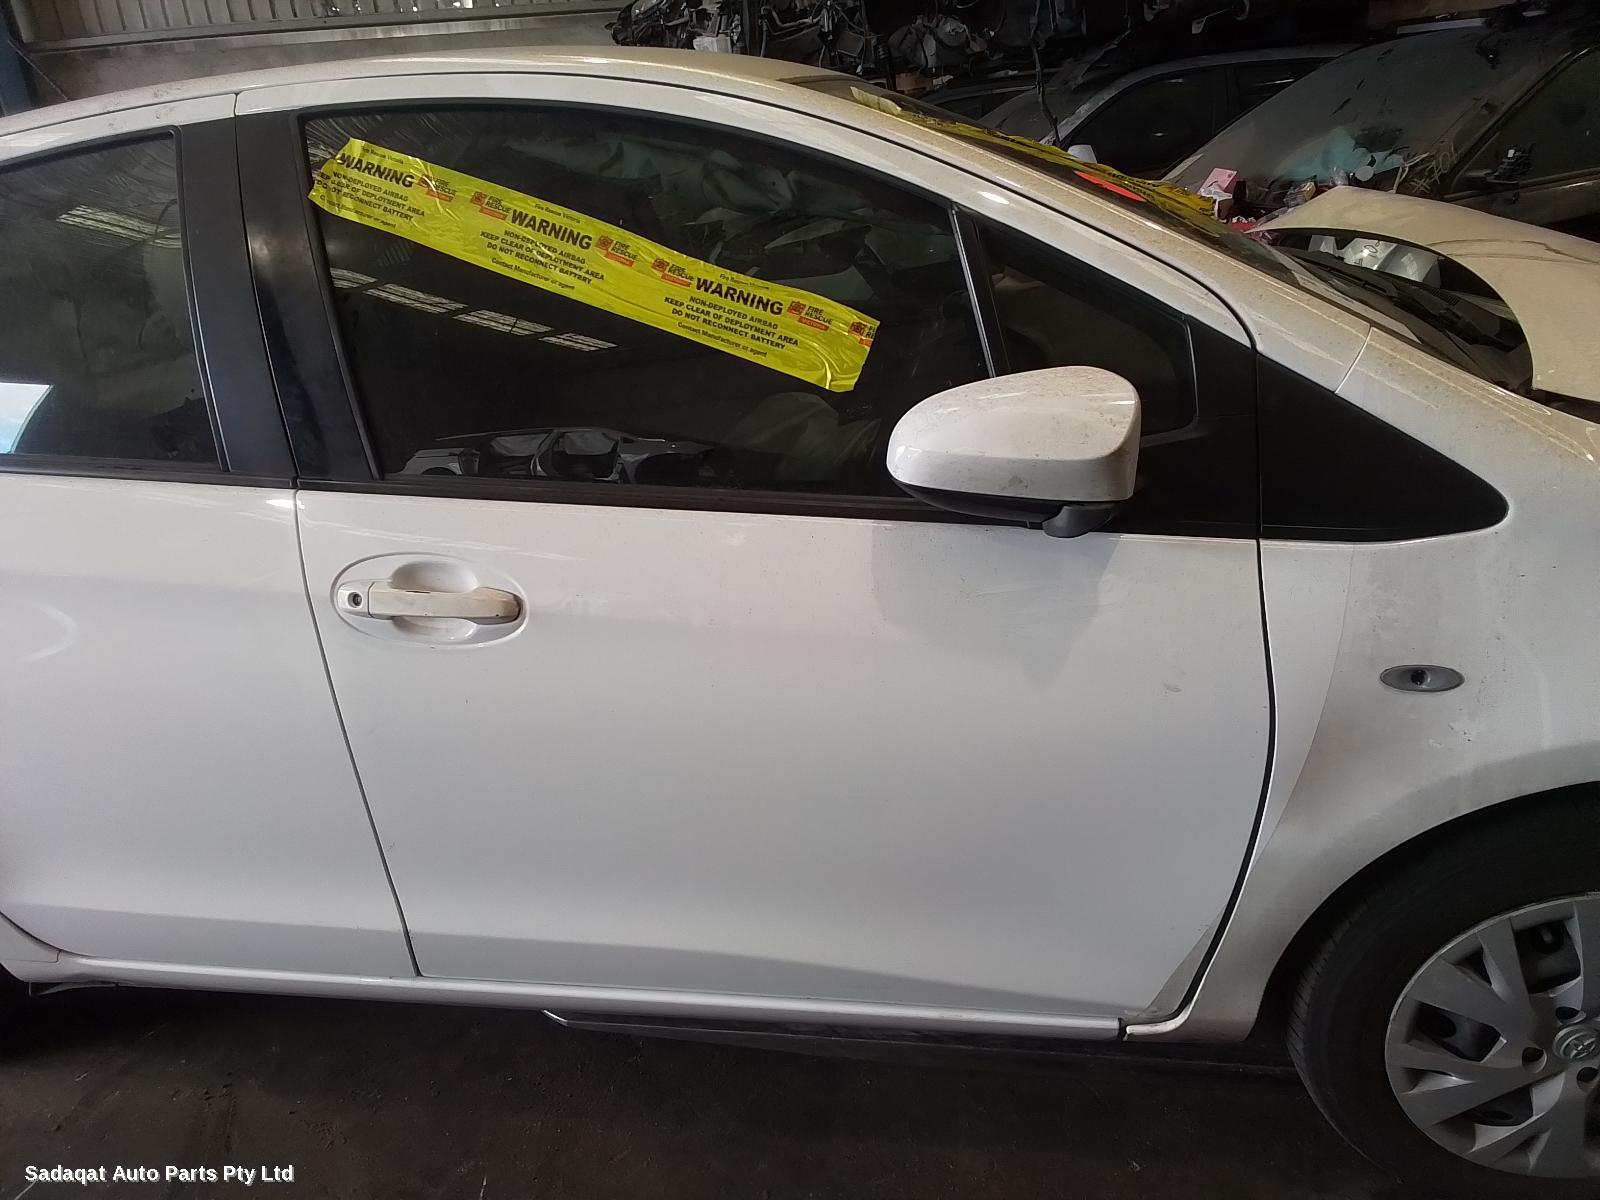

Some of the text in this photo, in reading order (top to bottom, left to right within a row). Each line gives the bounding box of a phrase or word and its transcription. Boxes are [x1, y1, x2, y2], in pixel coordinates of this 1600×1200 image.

[339, 153, 414, 188] WARNING
[352, 185, 360, 194] OF
[362, 190, 406, 211] DEPLOYMENT
[406, 206, 425, 217] AREA
[384, 188, 408, 202] AIRBAG
[486, 201, 512, 214] RESCUE
[488, 196, 503, 204] FIRE
[382, 206, 414, 221] BATTERY
[511, 209, 592, 250] WARNING
[480, 231, 604, 280] KEEP CLEAR OF DEPLOYMENT AREA
[504, 230, 558, 254] NON-DEPLOYED
[558, 250, 586, 265] AIRBAG
[612, 247, 638, 260] RESCUE
[614, 240, 630, 250] FIRE
[487, 242, 592, 284] DO NOT RECONNECT BATTERY
[492, 258, 514, 271] Contact
[514, 265, 550, 282] Manufacturer
[668, 268, 694, 282] RESCUE
[670, 264, 686, 272] FIRE
[696, 278, 784, 316] WARNING
[808, 306, 824, 316] FIRE
[664, 296, 798, 346] KEEP CLEAR OF DEPLOYMENT AREA
[690, 296, 778, 330] NON-DEPLOYED AIRBAG
[804, 312, 832, 325] RESCUE
[672, 308, 785, 350] DO NOT RECONNECT BATTERY
[678, 322, 700, 334] Contact
[702, 329, 741, 349] Manufacturer
[750, 347, 768, 358] agent
